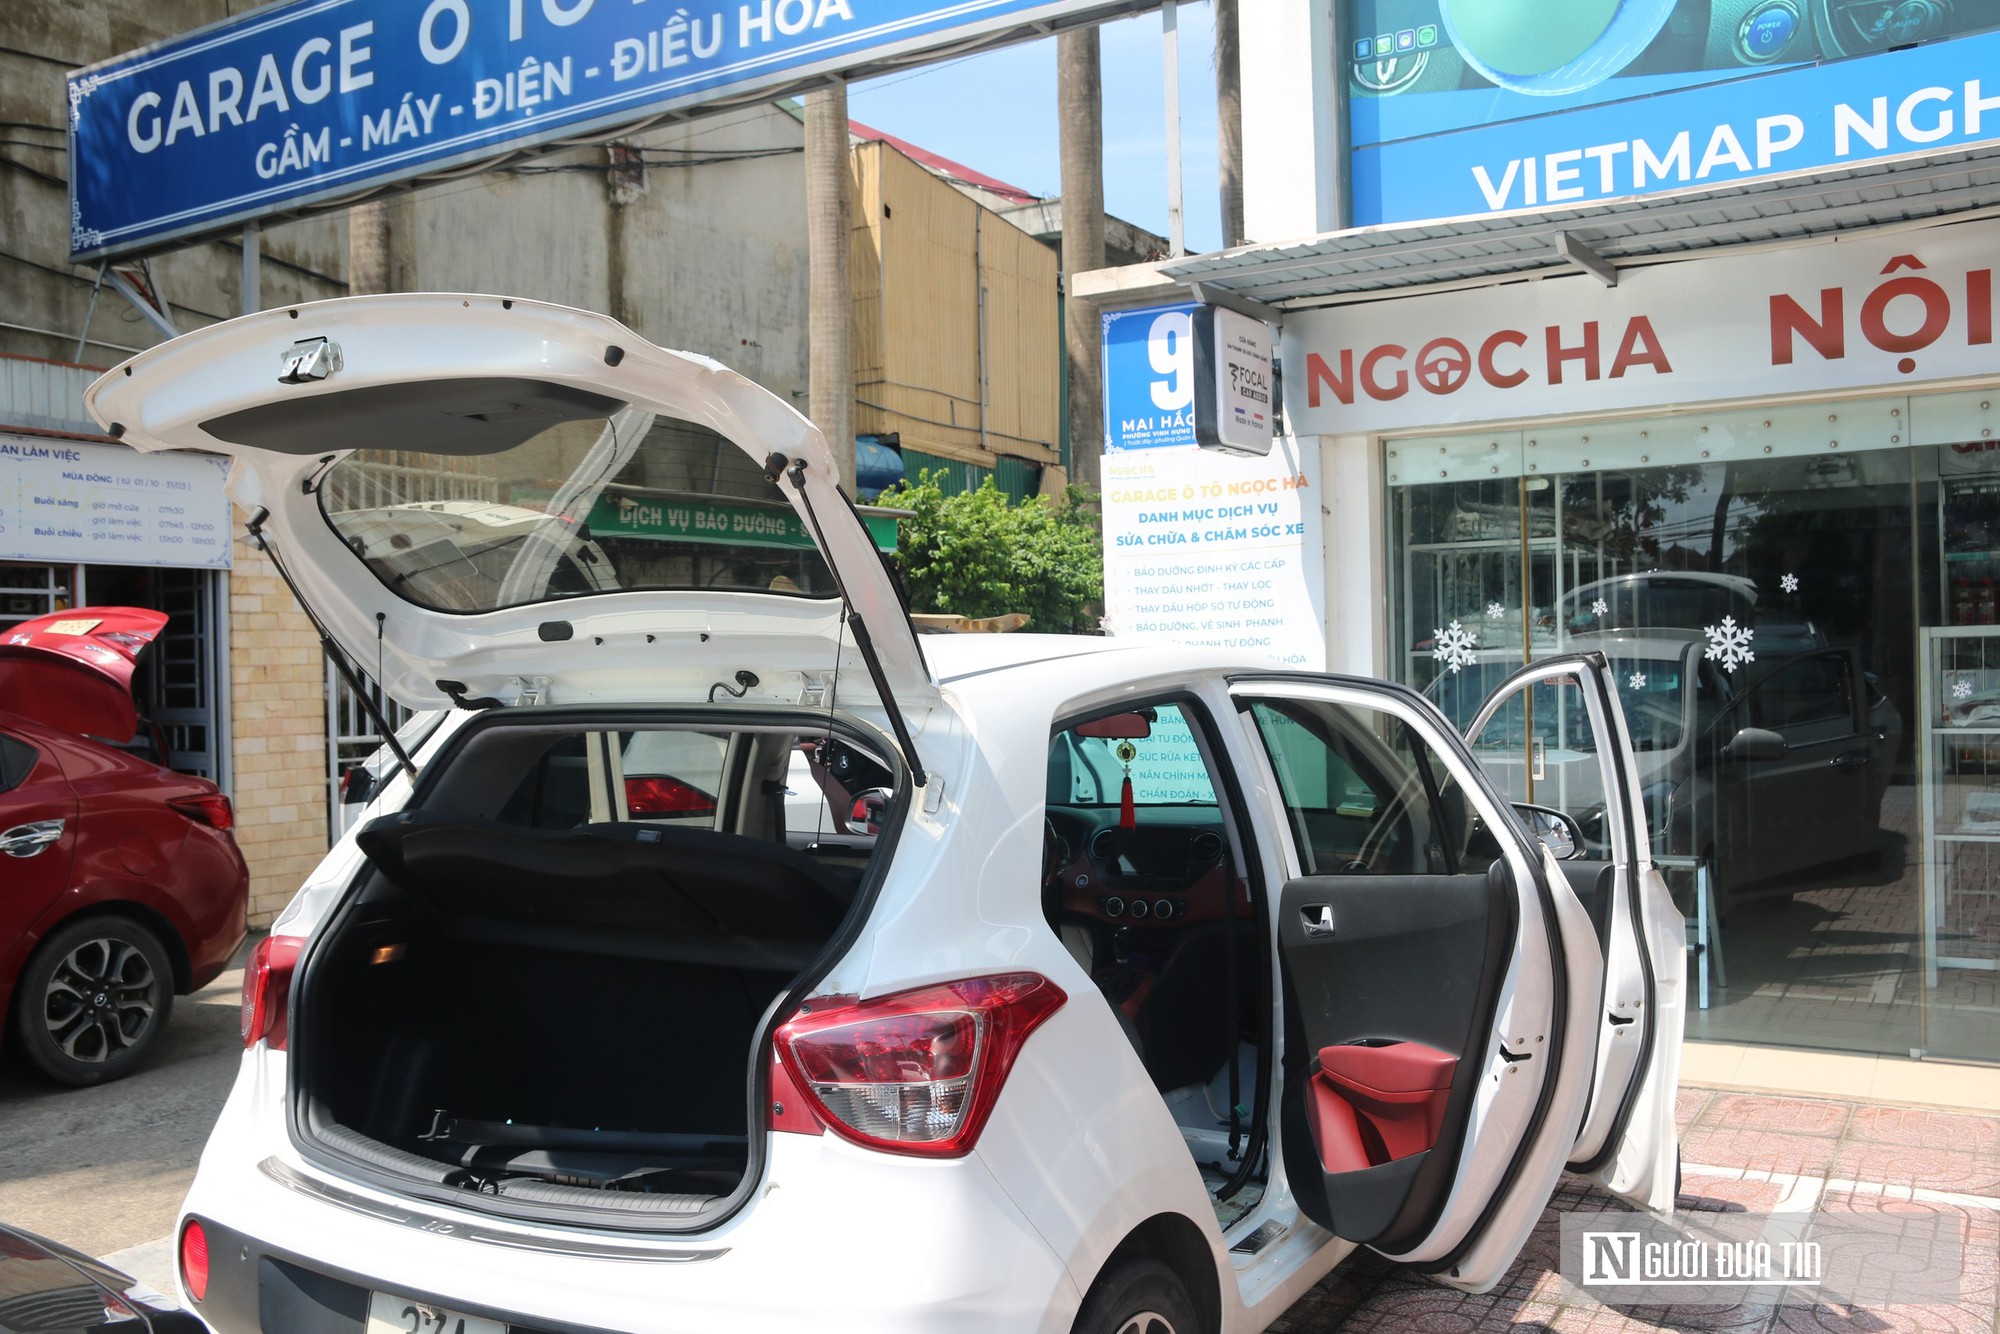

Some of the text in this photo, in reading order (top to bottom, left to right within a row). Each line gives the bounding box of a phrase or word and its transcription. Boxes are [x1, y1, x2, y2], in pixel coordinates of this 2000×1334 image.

[1757, 20, 1782, 31] POWER
[127, 20, 374, 154] GARAGE
[255, 123, 330, 180] GẦM
[362, 92, 442, 152] MÁY
[473, 56, 572, 118] ĐIỆN
[610, 8, 724, 83] ĐIỀU
[1471, 114, 1805, 211] VIETMAP
[1768, 254, 1992, 374] NỘI
[1240, 367, 1268, 391] FOCAL
[1122, 417, 1153, 432] MAI
[23, 445, 50, 459] LÀM
[53, 450, 81, 462] VIỆC
[86, 473, 113, 484] ĐÔNG
[1110, 471, 1309, 503] GARAGE Ô TÔ NGỌC HÀ
[57, 499, 79, 509] sáng
[620, 505, 662, 529] DỊCH
[667, 508, 690, 533] VỤ
[695, 507, 728, 531] BẢO
[732, 511, 786, 535] DƯỠNG
[1138, 502, 1279, 524] DANH MỤC DỊCH VỤ
[1116, 522, 1305, 547] SỬA CHỮA & CHĂM SÓC XE
[1134, 565, 1155, 577] BẢO
[1157, 566, 1195, 577] DƯỠNG
[1197, 564, 1223, 577] ĐỊNH
[1240, 560, 1262, 571] CÁC
[1264, 557, 1286, 570] CẤP
[1135, 585, 1160, 595] THAY
[1223, 581, 1249, 592] THAY
[1251, 579, 1273, 591] LỌC
[1136, 604, 1161, 614] THAY
[1243, 598, 1275, 611] ĐỘNG
[1136, 621, 1157, 632] BẢO
[1216, 619, 1241, 629] SINH
[1246, 617, 1284, 628] PHANH
[1239, 636, 1271, 647] ĐỘNG
[1283, 653, 1307, 664] HÒA
[1170, 788, 1200, 799] ĐOÁN
